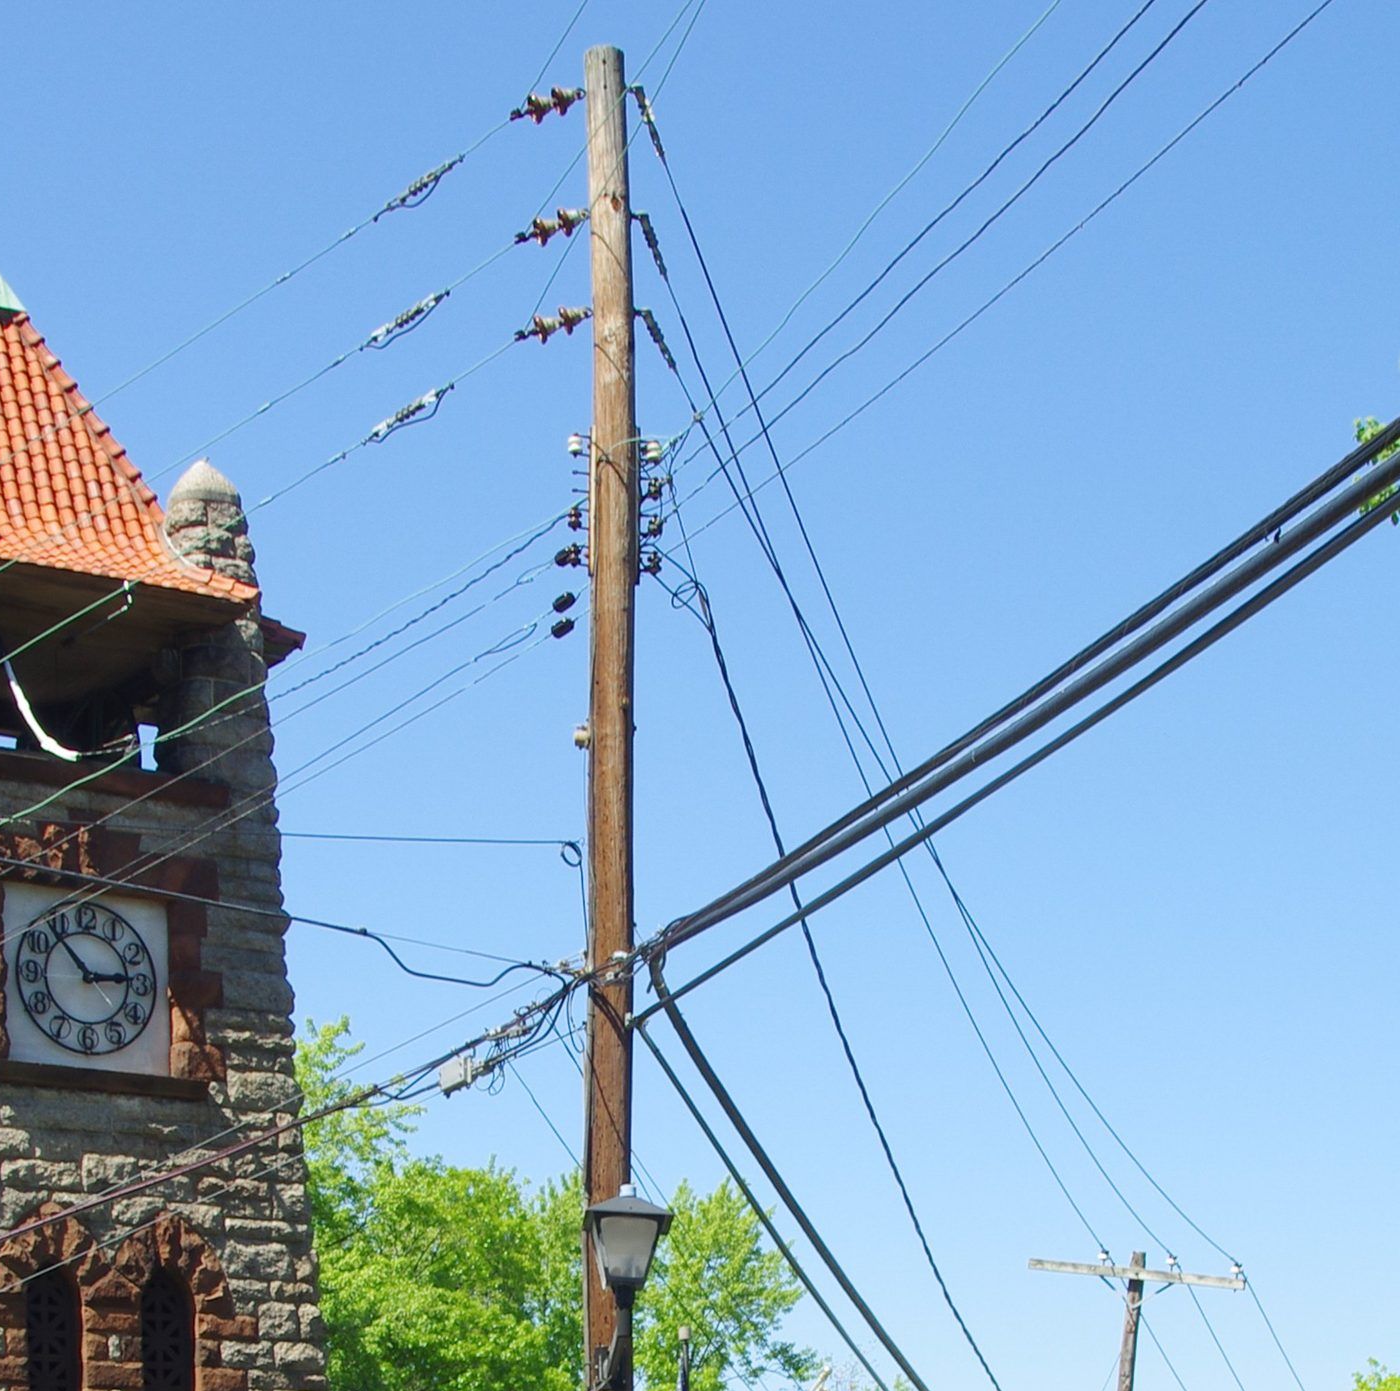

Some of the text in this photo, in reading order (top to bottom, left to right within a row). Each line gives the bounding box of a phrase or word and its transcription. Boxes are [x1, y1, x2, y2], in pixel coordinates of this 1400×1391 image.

[78, 906, 97, 930] 12
[30, 931, 49, 954] 10
[125, 1003, 141, 1025] 4
